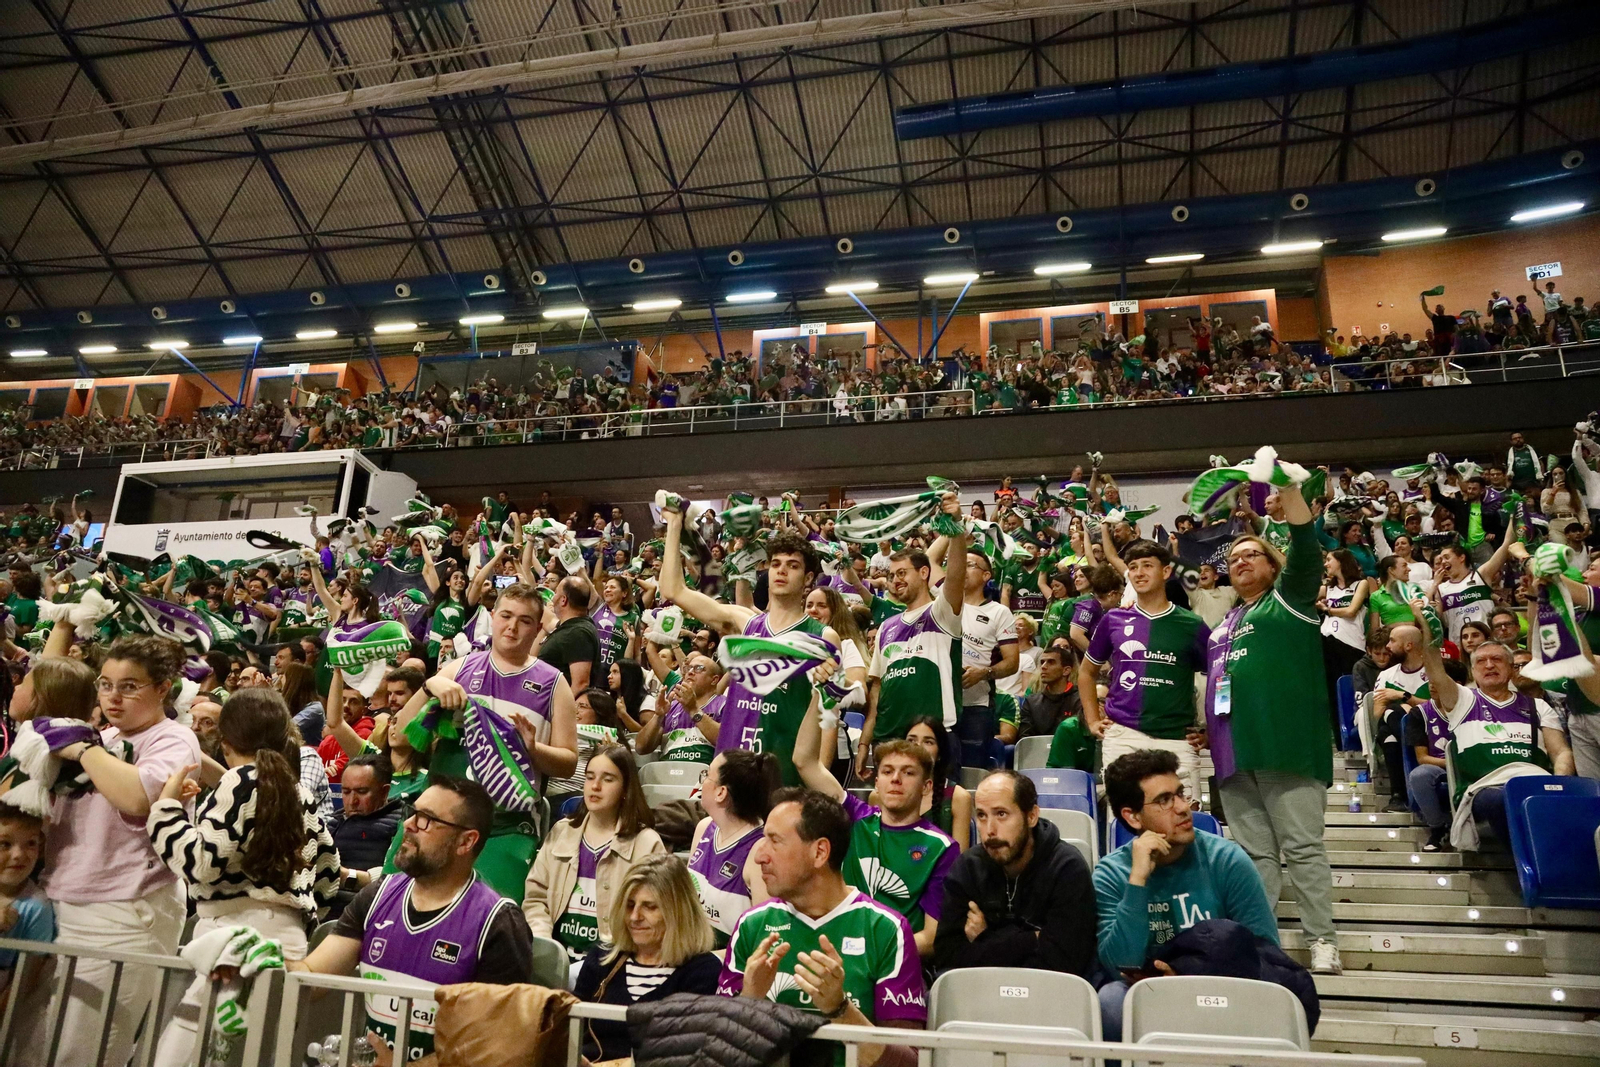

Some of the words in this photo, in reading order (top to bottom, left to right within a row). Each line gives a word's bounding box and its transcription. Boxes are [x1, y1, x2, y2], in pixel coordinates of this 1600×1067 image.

[1529, 263, 1558, 272] SECTOR
[174, 531, 232, 543] Ayuntamiento
[235, 531, 246, 540] de
[1456, 591, 1482, 602] Unicaja
[1332, 620, 1339, 633] 9
[1143, 650, 1177, 664] Unicaja
[669, 750, 701, 760] málaga
[1335, 876, 1343, 884] 7
[1382, 939, 1391, 949] 6
[1006, 987, 1022, 997] 63
[1204, 996, 1219, 1006] 64
[1451, 1031, 1461, 1044] 5
